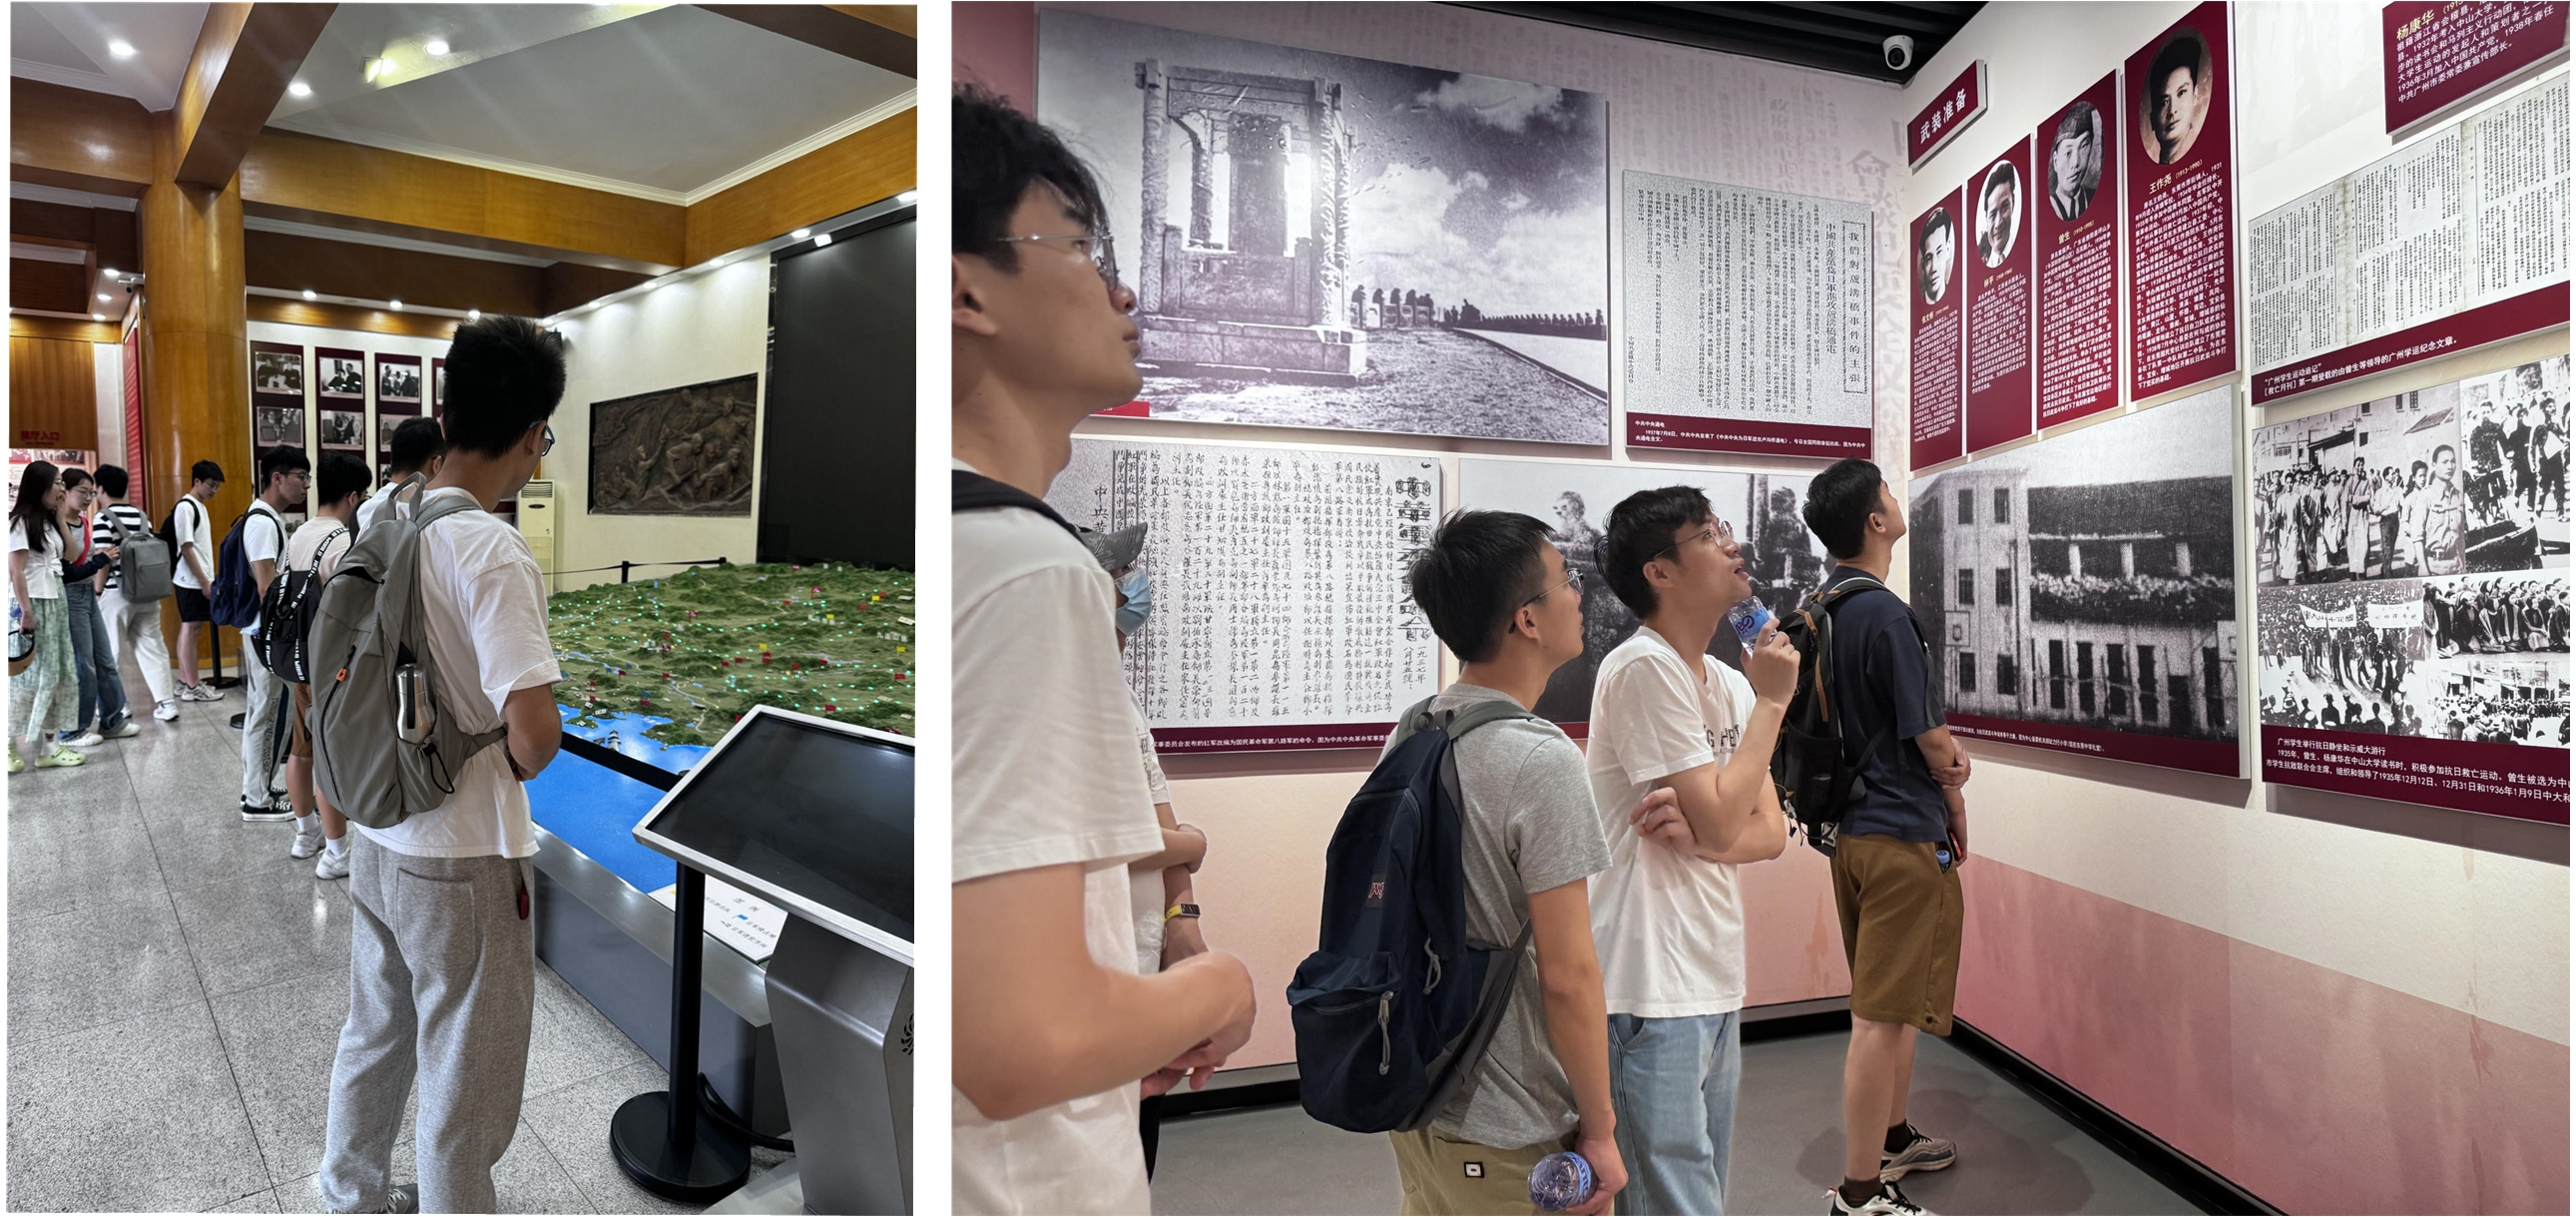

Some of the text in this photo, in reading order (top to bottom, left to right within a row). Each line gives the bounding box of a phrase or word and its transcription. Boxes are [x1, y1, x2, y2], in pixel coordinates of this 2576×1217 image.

[2396, 9, 2435, 41] 杨康华
[1920, 88, 1966, 144] 武装准备
[2149, 173, 2172, 194] 王作尧
[2277, 738, 2386, 756] 广州学生举行抗日静坐和示威大游行
